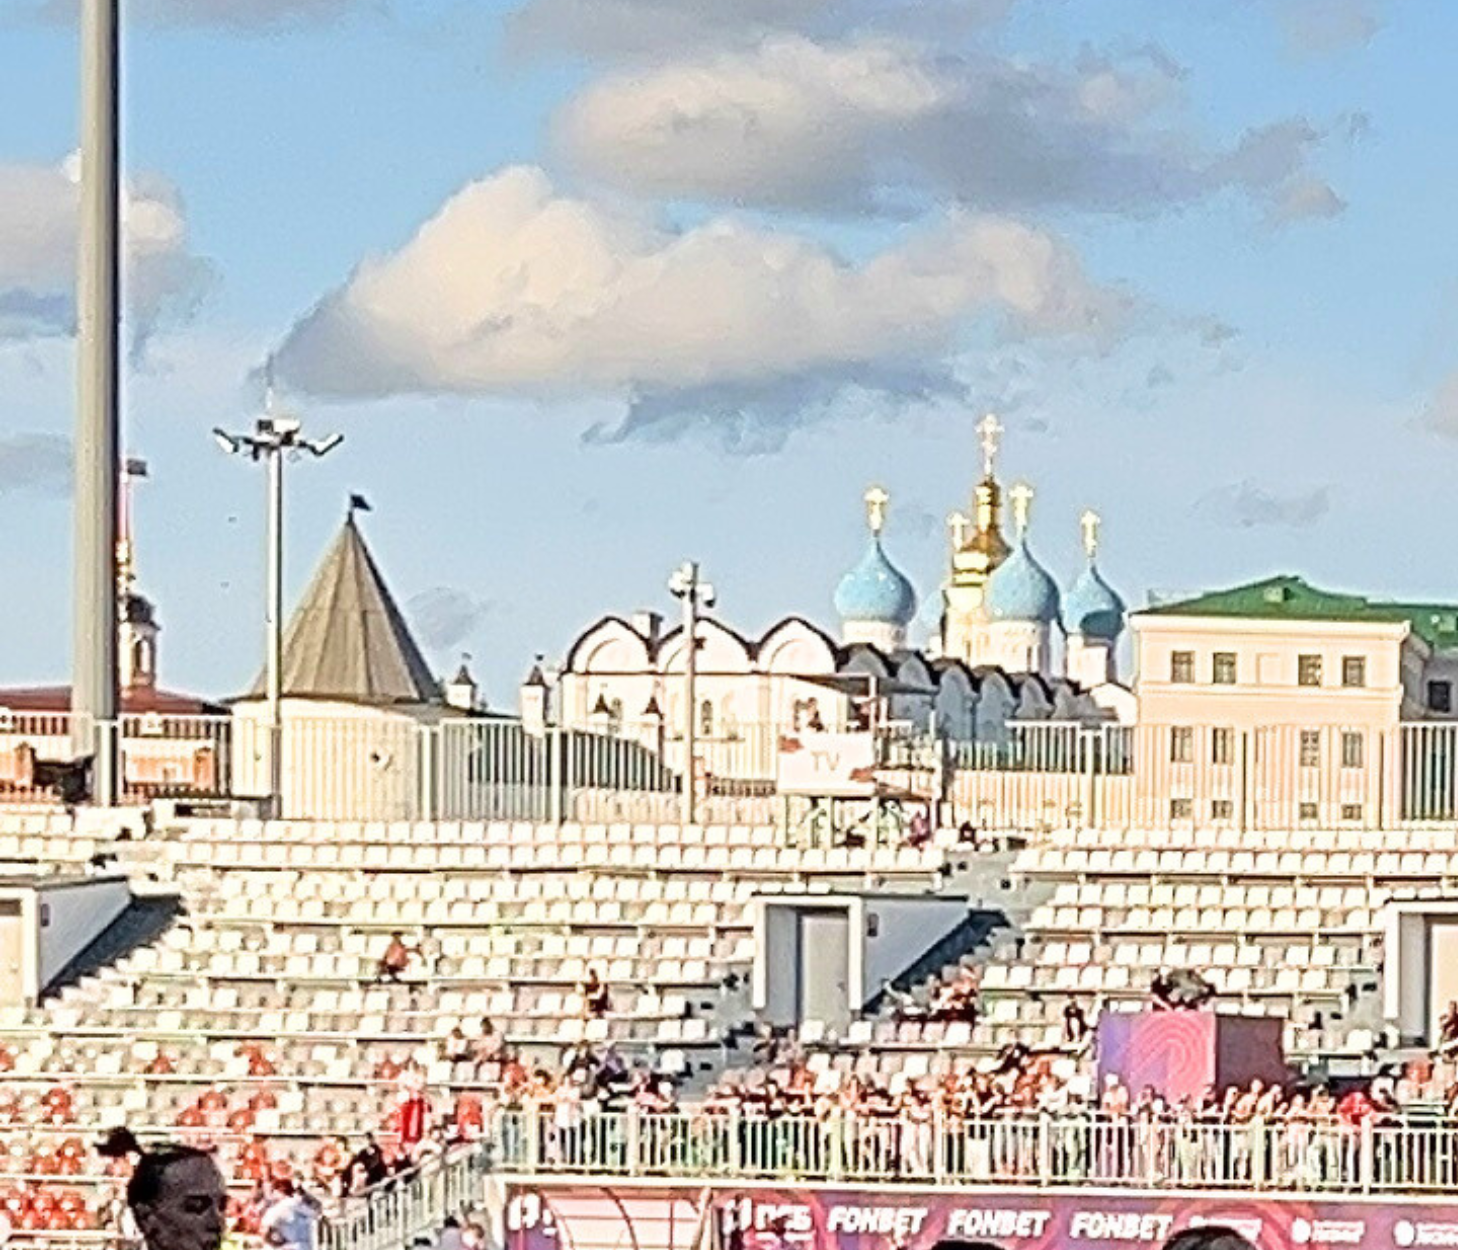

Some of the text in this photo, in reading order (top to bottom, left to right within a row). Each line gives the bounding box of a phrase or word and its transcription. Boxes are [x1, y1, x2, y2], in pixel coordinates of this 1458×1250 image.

[827, 1206, 928, 1234] FONBET
[946, 1208, 1051, 1238] FONBET
[1068, 1211, 1173, 1241] FONBET
